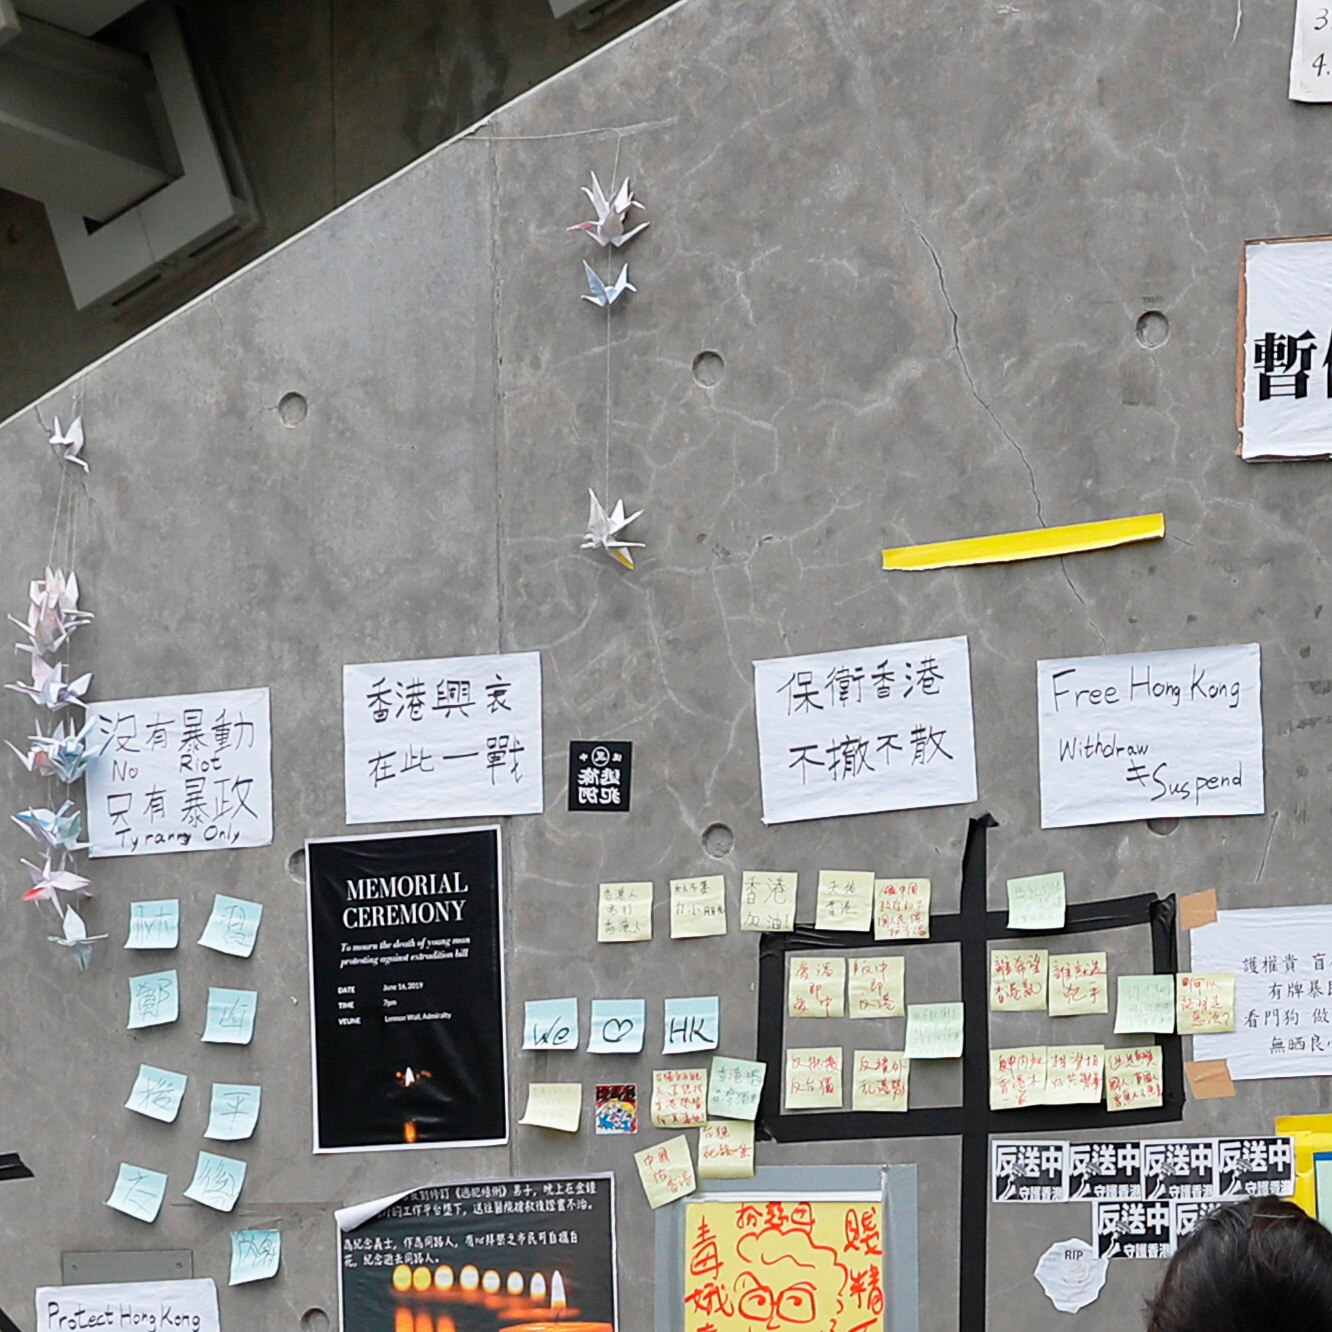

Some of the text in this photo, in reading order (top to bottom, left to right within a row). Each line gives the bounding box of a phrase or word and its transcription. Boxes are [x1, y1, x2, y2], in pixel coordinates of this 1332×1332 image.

[366, 673, 513, 724] 香港興衰
[777, 659, 945, 716] 保衛香港
[1052, 665, 1242, 712] Free Hong Kong
[99, 709, 254, 757] 沒有暴動
[1059, 733, 1149, 762] Withdraw
[113, 754, 222, 781] No Riot
[368, 735, 525, 788] 在此一戰
[788, 725, 954, 785] 不撤不散
[1151, 762, 1244, 805] Suspend
[107, 775, 258, 828] 只有暴政
[203, 825, 240, 846] Only
[346, 872, 469, 901] MEMORIAL
[745, 876, 787, 905] 香港
[342, 900, 467, 930] CEREMONY
[534, 1016, 570, 1045] We
[670, 1016, 714, 1043] HK
[1064, 1249, 1084, 1261] RIP
[48, 1301, 114, 1331] Protect
[160, 1306, 201, 1332] Kong
